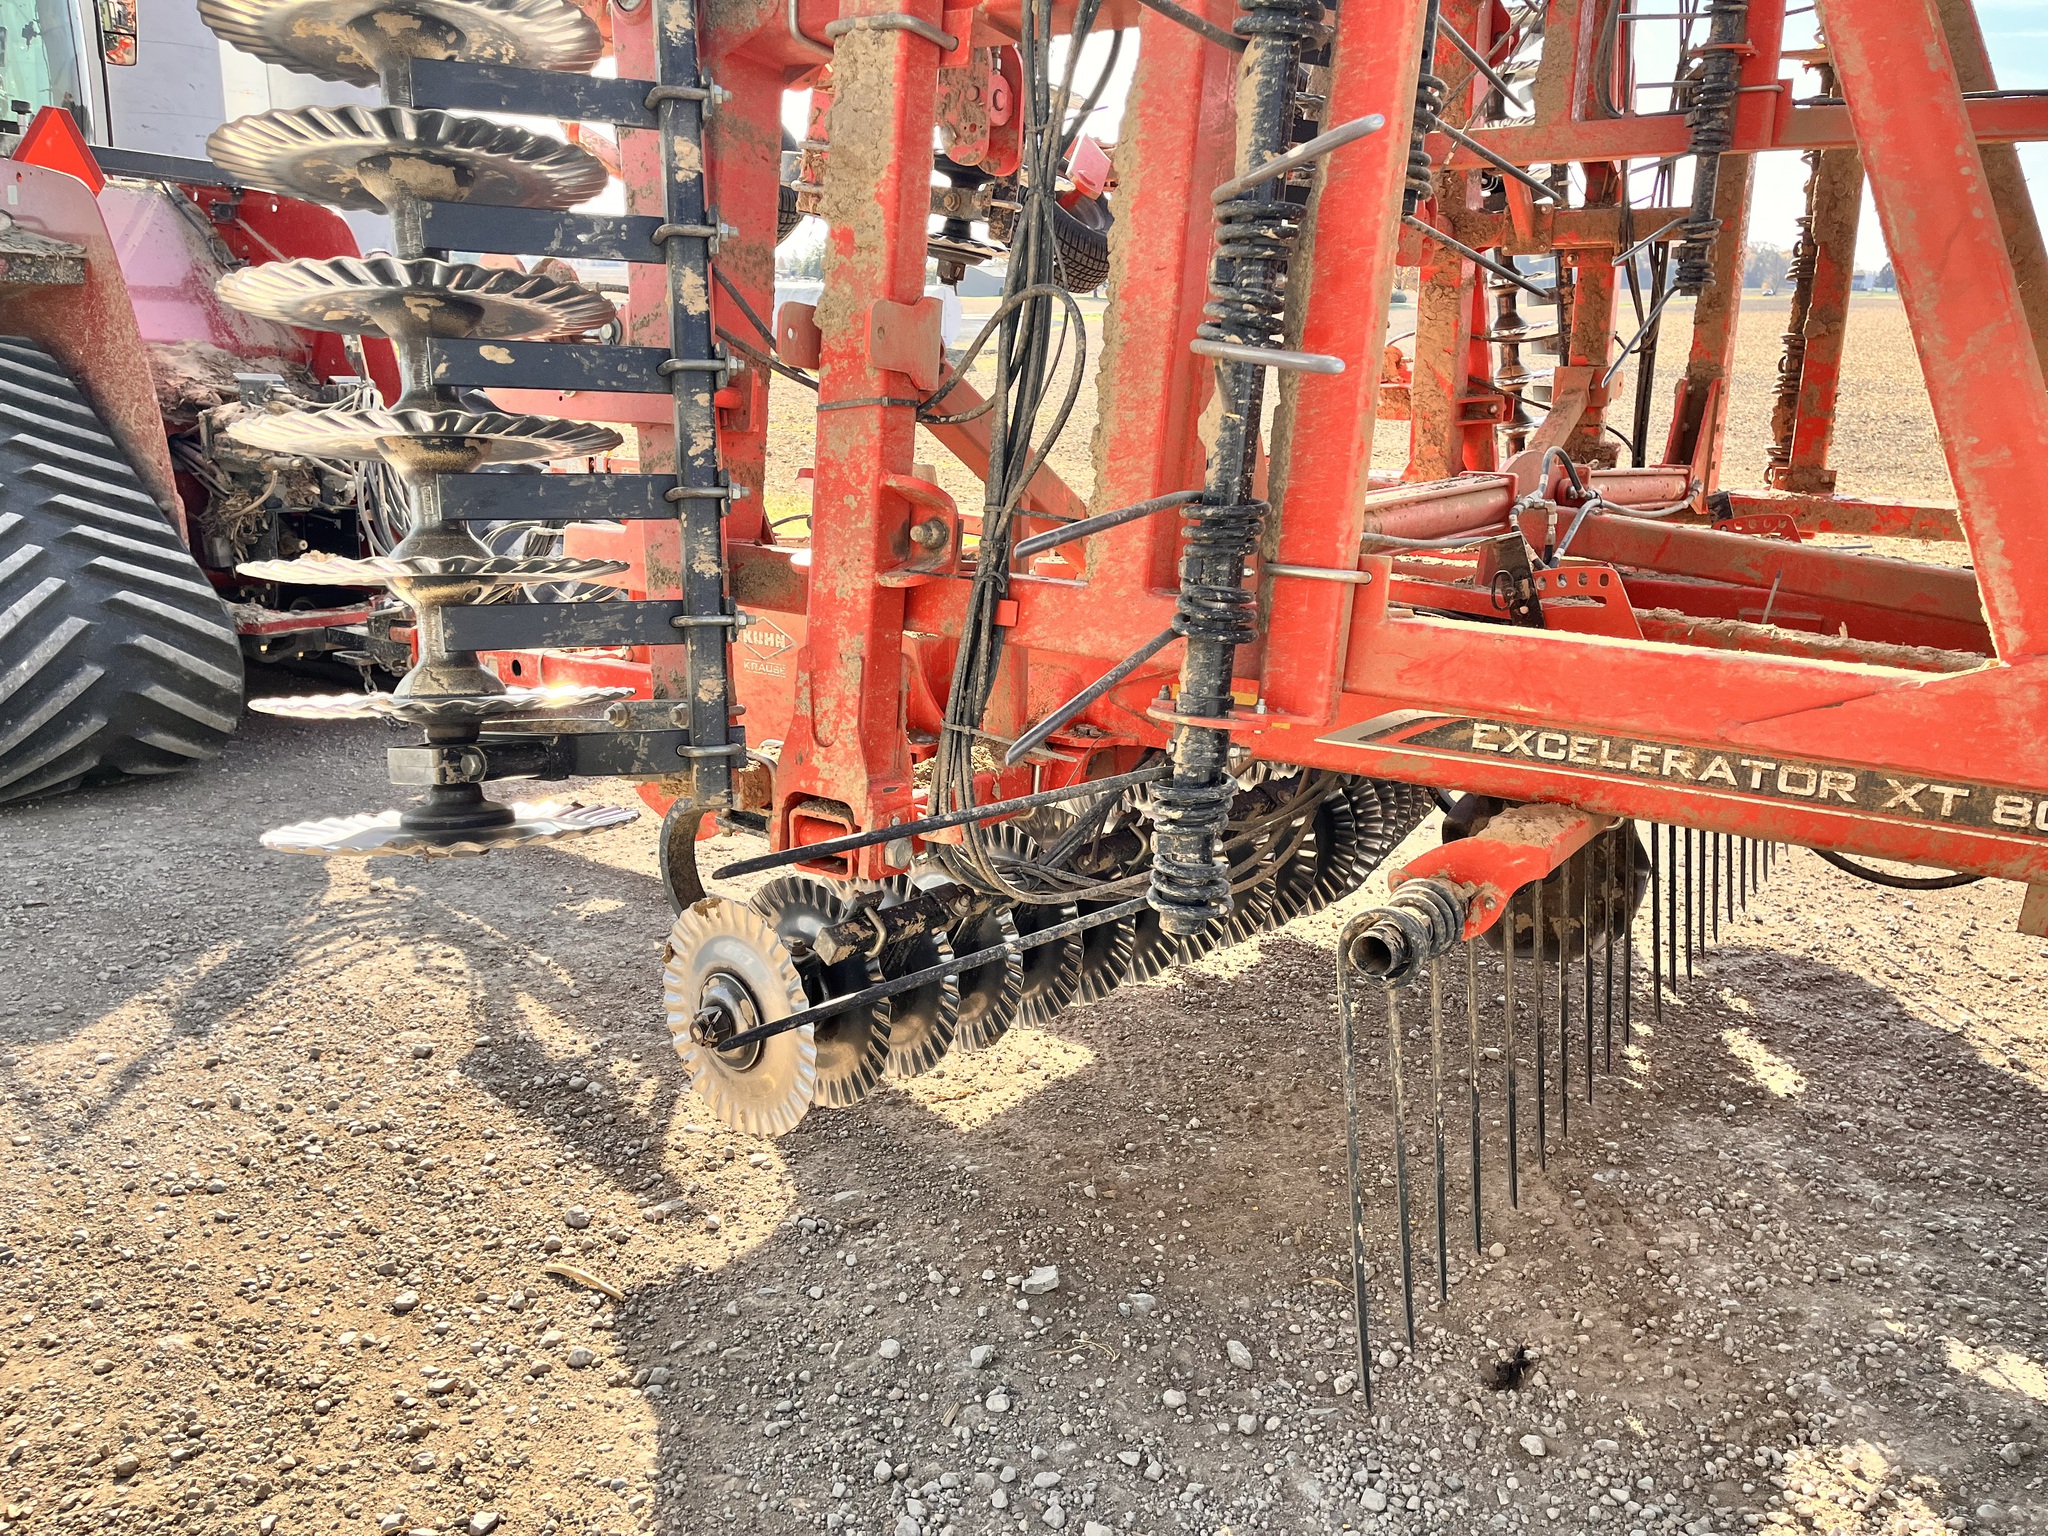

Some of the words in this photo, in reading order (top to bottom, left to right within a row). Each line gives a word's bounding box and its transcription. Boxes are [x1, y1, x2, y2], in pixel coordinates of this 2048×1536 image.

[743, 630, 786, 648] KUHN
[743, 661, 786, 674] KRAUSE
[1471, 722, 1857, 803] EXCELERATOR
[1881, 778, 1970, 817] XT
